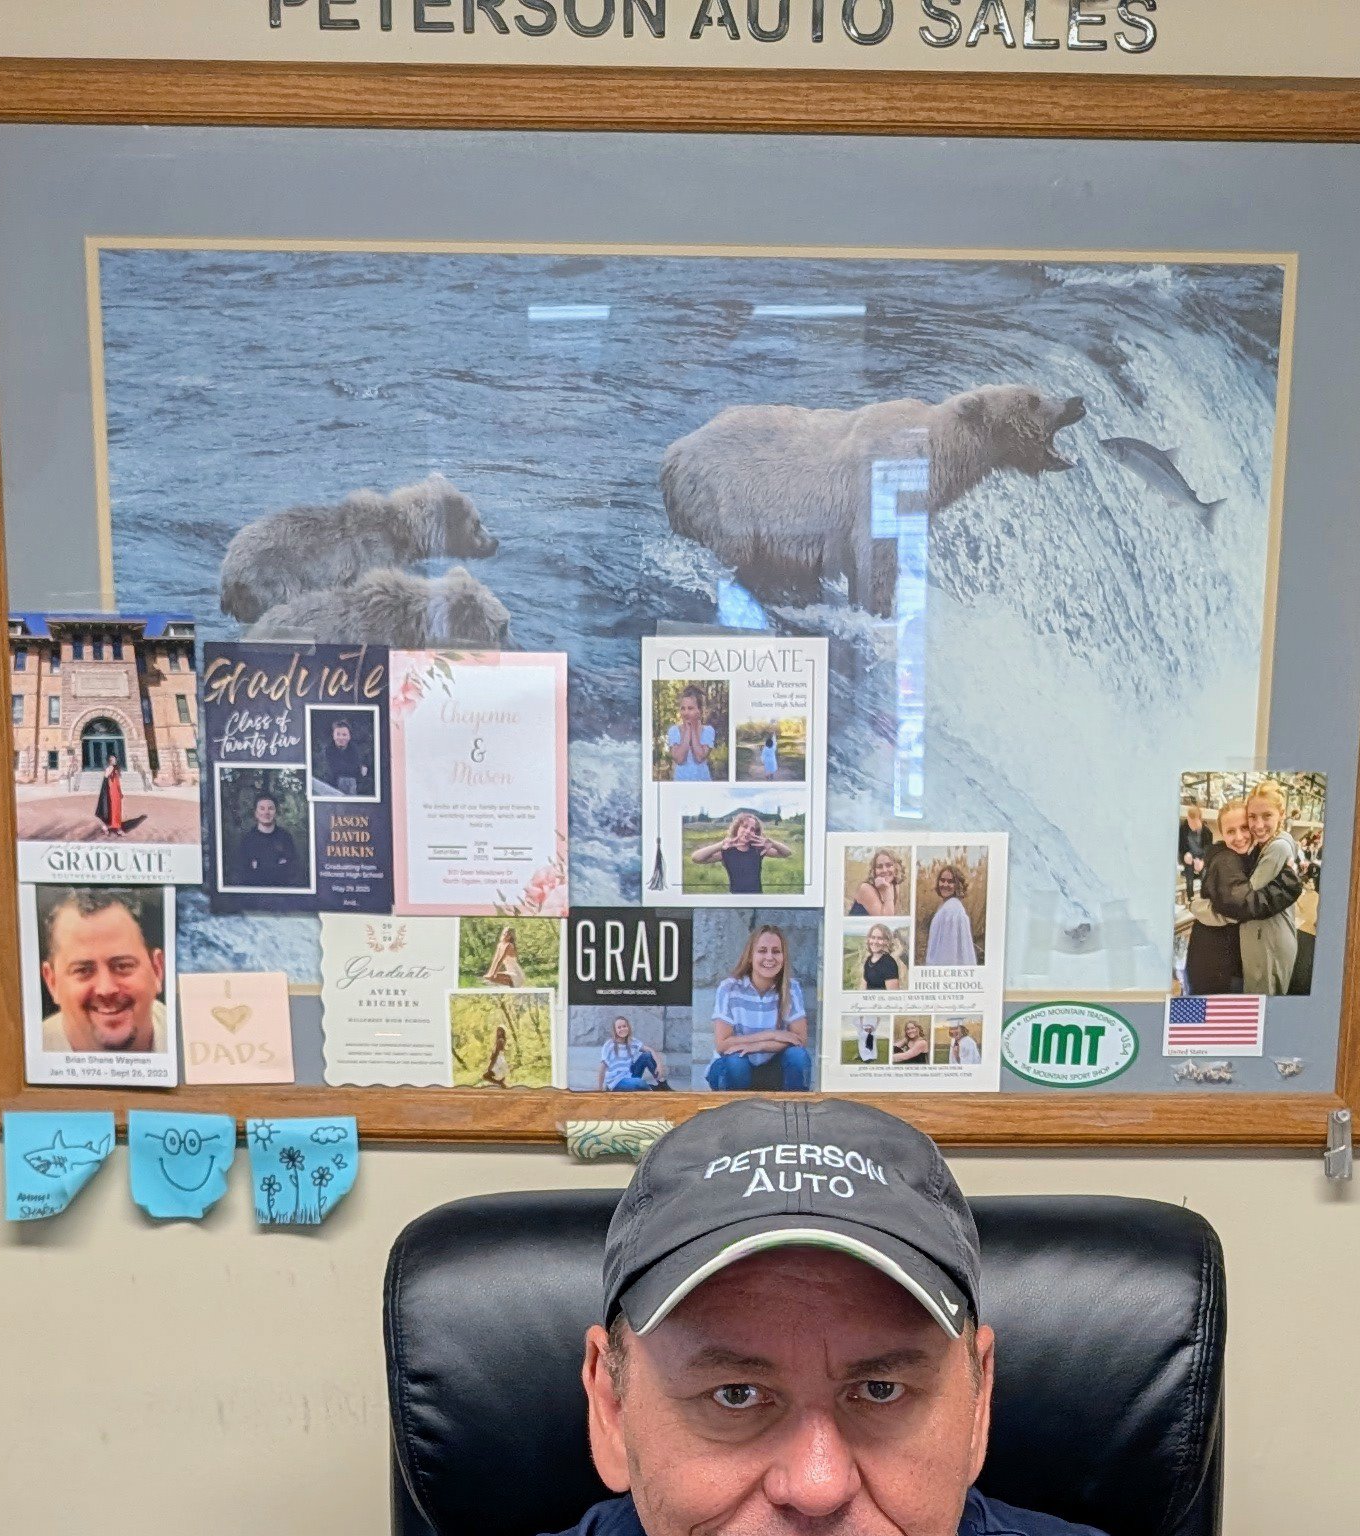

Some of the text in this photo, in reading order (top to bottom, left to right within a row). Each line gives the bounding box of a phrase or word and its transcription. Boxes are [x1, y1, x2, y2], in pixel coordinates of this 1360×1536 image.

[918, 0, 1158, 53] SALES
[668, 649, 803, 672] GRADUATE
[203, 644, 386, 709] Graduate
[225, 711, 270, 736] Class
[470, 738, 486, 763] &
[331, 815, 369, 828] JASON
[331, 830, 371, 842] DAVID
[48, 851, 172, 872] GRADUATE
[326, 845, 374, 858] PARKIN
[576, 920, 679, 982] GRAD
[337, 955, 444, 989] Graduate
[370, 988, 407, 996] AVERY
[190, 1041, 275, 1066] DADS
[1029, 1023, 1105, 1066] IMT
[704, 1144, 889, 1185] PETERSON
[742, 1168, 855, 1198] AUTO
